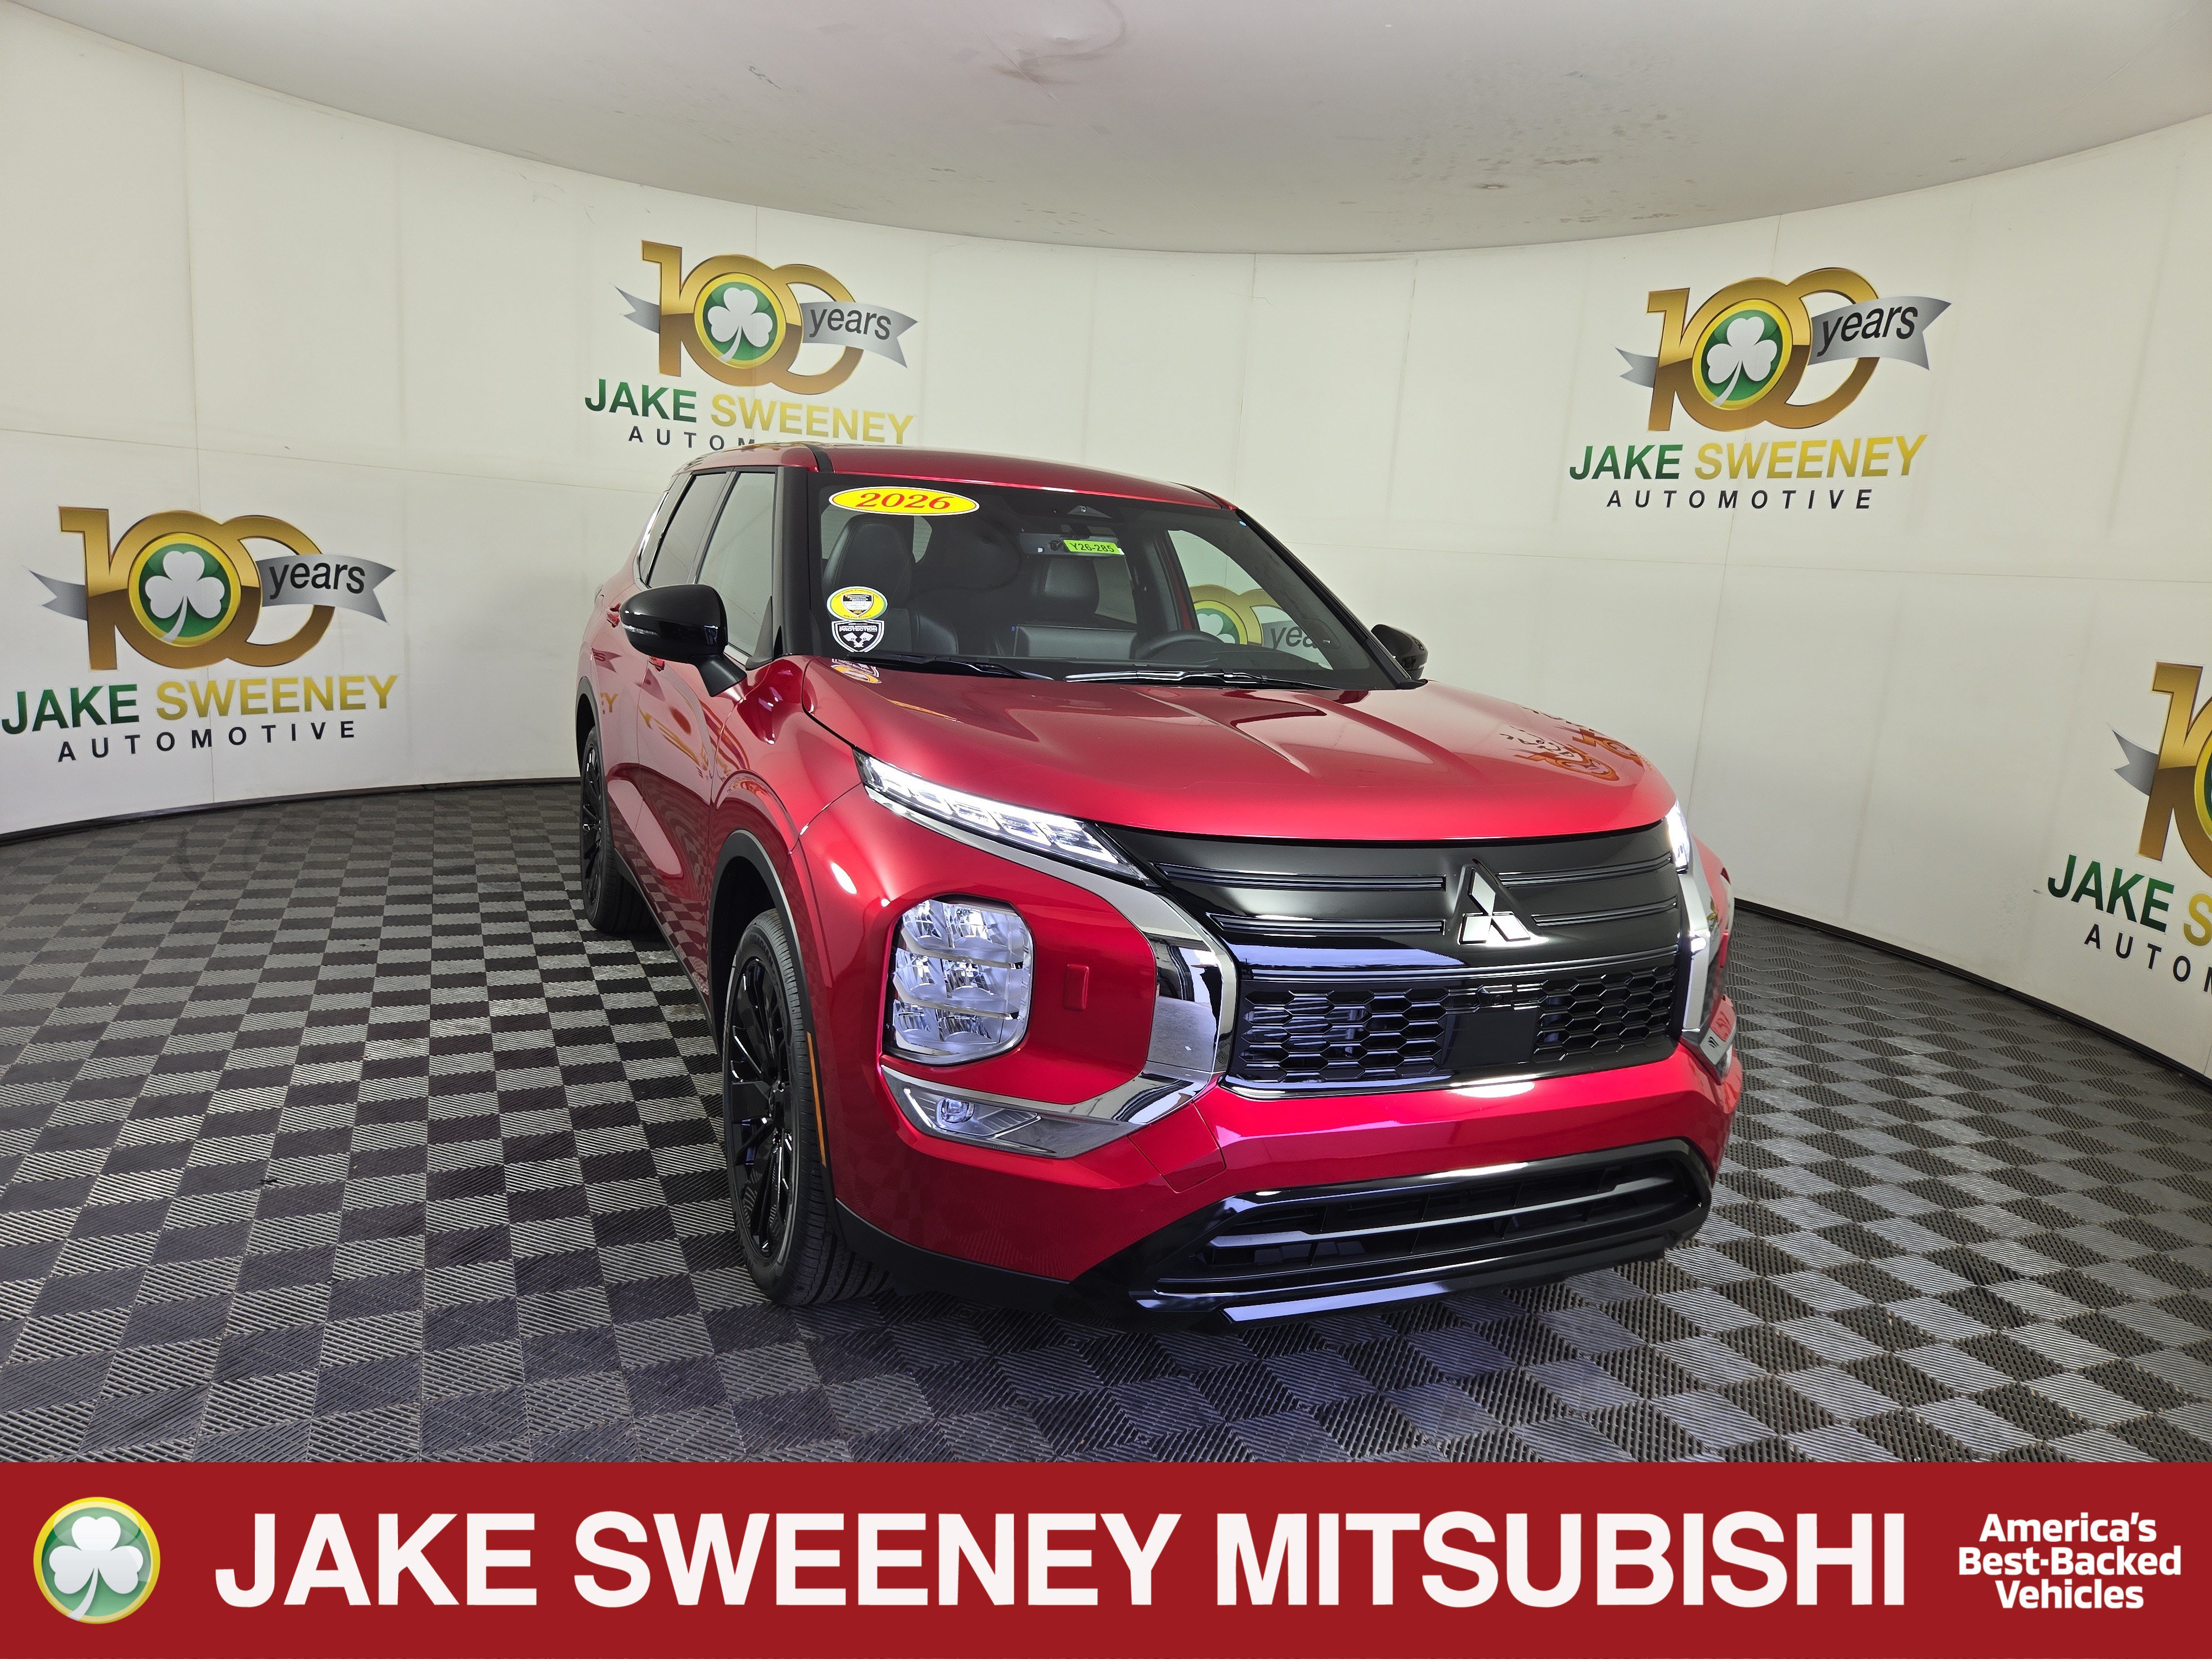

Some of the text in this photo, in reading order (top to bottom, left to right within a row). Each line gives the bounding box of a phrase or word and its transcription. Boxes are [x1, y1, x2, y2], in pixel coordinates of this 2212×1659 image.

[809, 307, 891, 340] years
[1817, 306, 1918, 357] years
[585, 378, 915, 445] JAKE SWEENEY
[1570, 435, 1928, 480] JAKE SWEENEY
[856, 493, 954, 509] 2026
[1607, 489, 1872, 509] AUTOMOTIVE
[1069, 543, 1114, 552] Y26-285
[269, 562, 366, 600] years
[1, 676, 398, 735] JAKE SWEENEY
[58, 721, 355, 762] AUTOMOTIVE
[2048, 853, 2175, 933] JAKE
